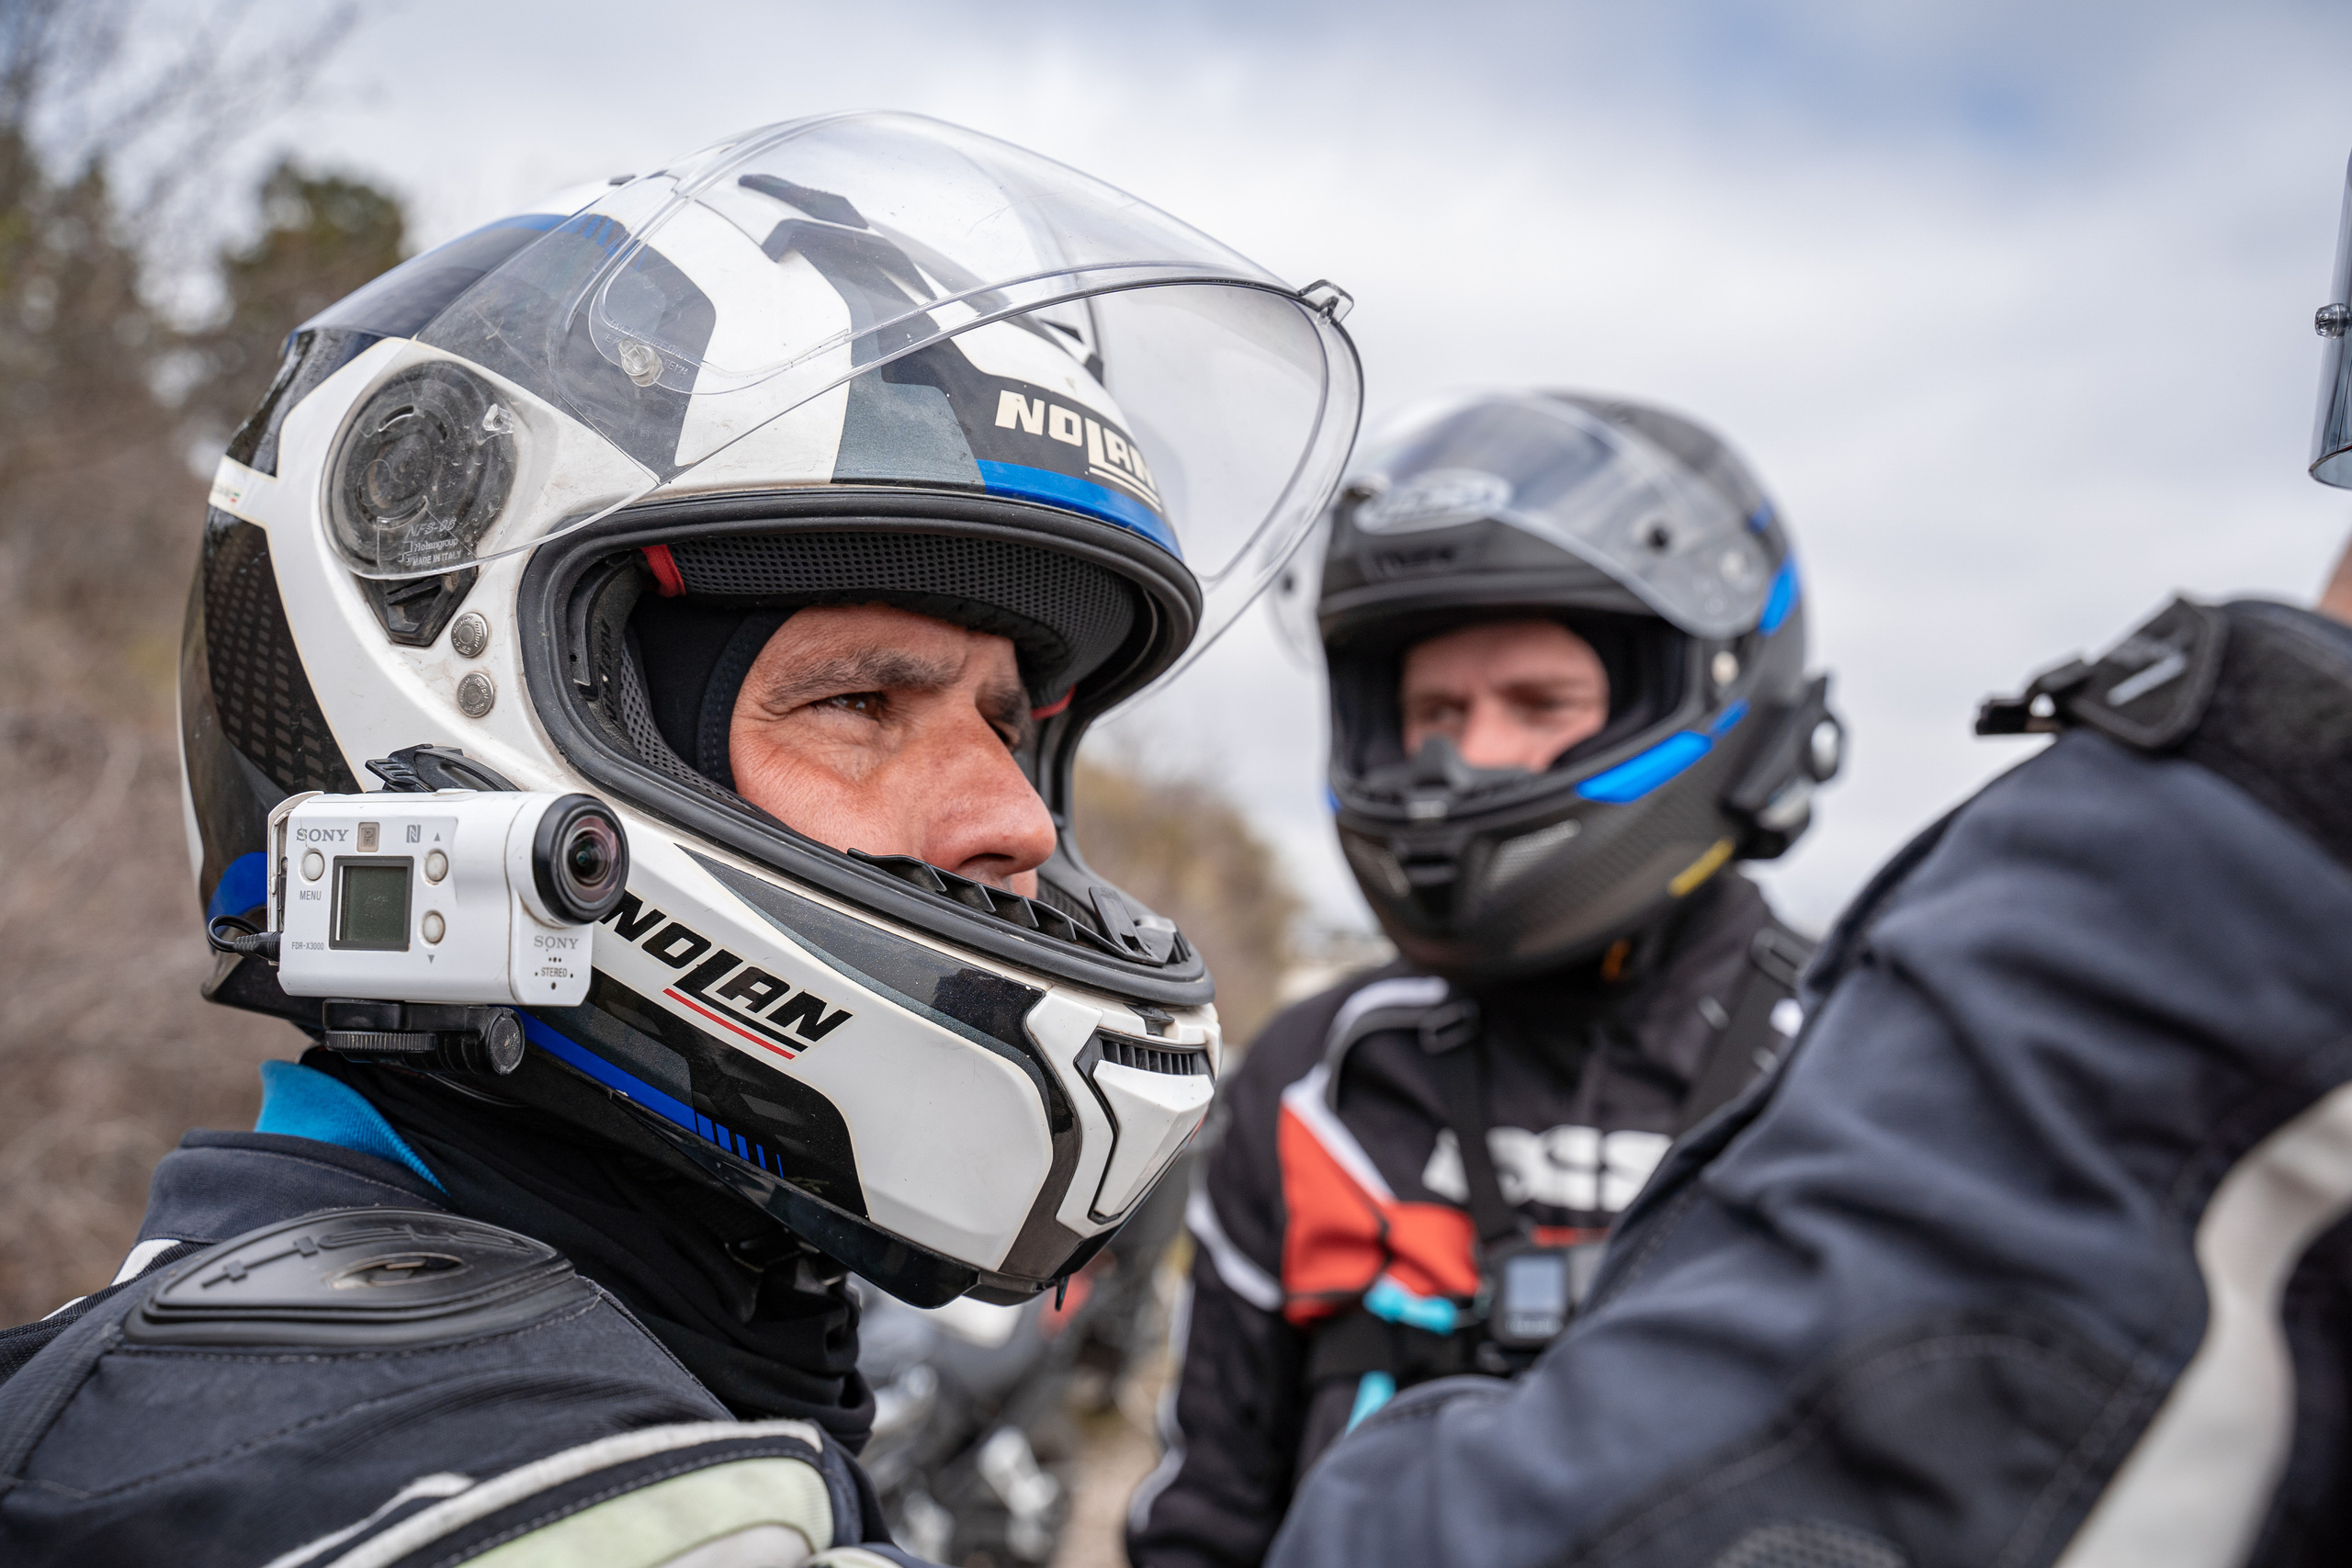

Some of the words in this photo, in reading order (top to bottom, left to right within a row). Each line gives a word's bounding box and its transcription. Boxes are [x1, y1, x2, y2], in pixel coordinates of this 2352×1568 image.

[995, 389, 1160, 504] NOLAN
[413, 555, 432, 567] MADE
[433, 554, 441, 563] IN
[442, 550, 462, 562] ITALY
[296, 828, 349, 842] SONY
[299, 890, 322, 901] MENU
[291, 942, 324, 951] FDR-X3000
[534, 935, 579, 950] SONY
[541, 966, 568, 978] STEREO
[598, 889, 854, 1053] NOLAN
